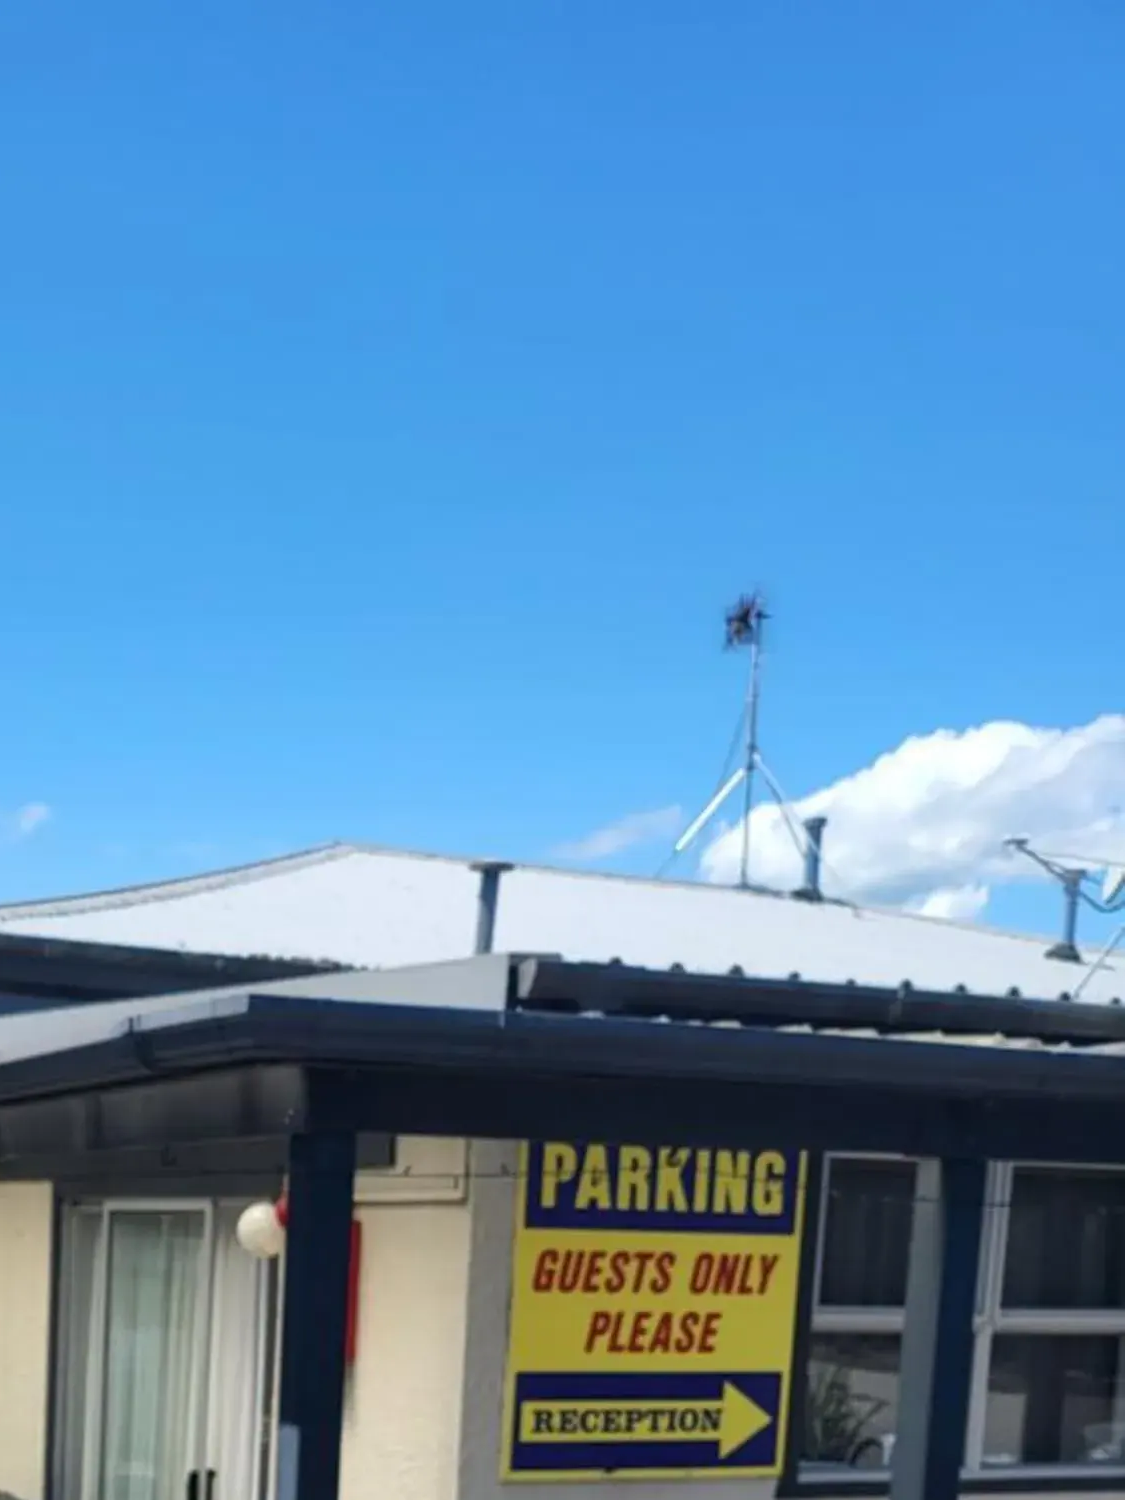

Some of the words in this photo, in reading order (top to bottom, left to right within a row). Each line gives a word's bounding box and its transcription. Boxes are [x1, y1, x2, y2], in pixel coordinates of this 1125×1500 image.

[540, 1142, 787, 1216] PARKING
[532, 1249, 676, 1293] GUESTS
[689, 1253, 779, 1295] ONLY
[583, 1311, 722, 1354] PLEASE
[530, 1408, 723, 1434] RECEPTION
